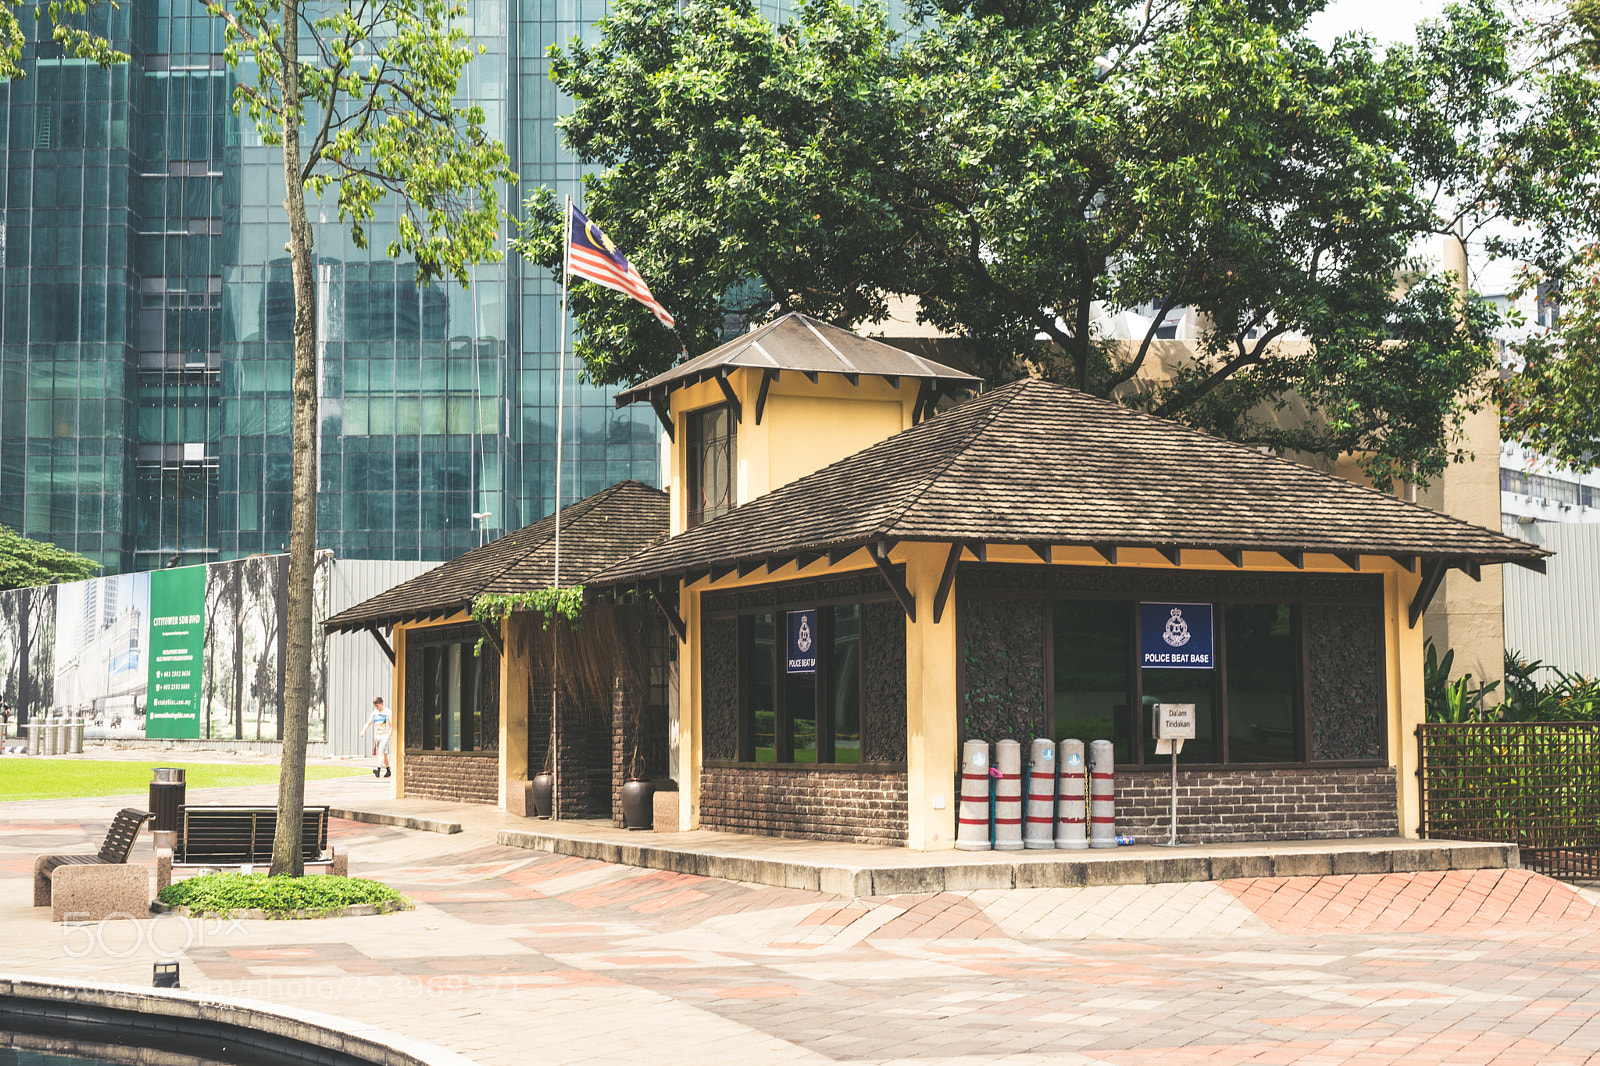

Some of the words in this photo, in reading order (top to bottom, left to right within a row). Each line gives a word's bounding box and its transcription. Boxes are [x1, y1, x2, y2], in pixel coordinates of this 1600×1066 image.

[178, 615, 189, 625] SDN
[189, 614, 200, 624] BHD
[789, 659, 801, 668] POLICE
[802, 658, 811, 667] BEAT
[1144, 653, 1170, 663] POLICE
[1171, 653, 1190, 663] BEAT
[1190, 654, 1209, 663] BASE
[1166, 720, 1190, 728] Tindakan
